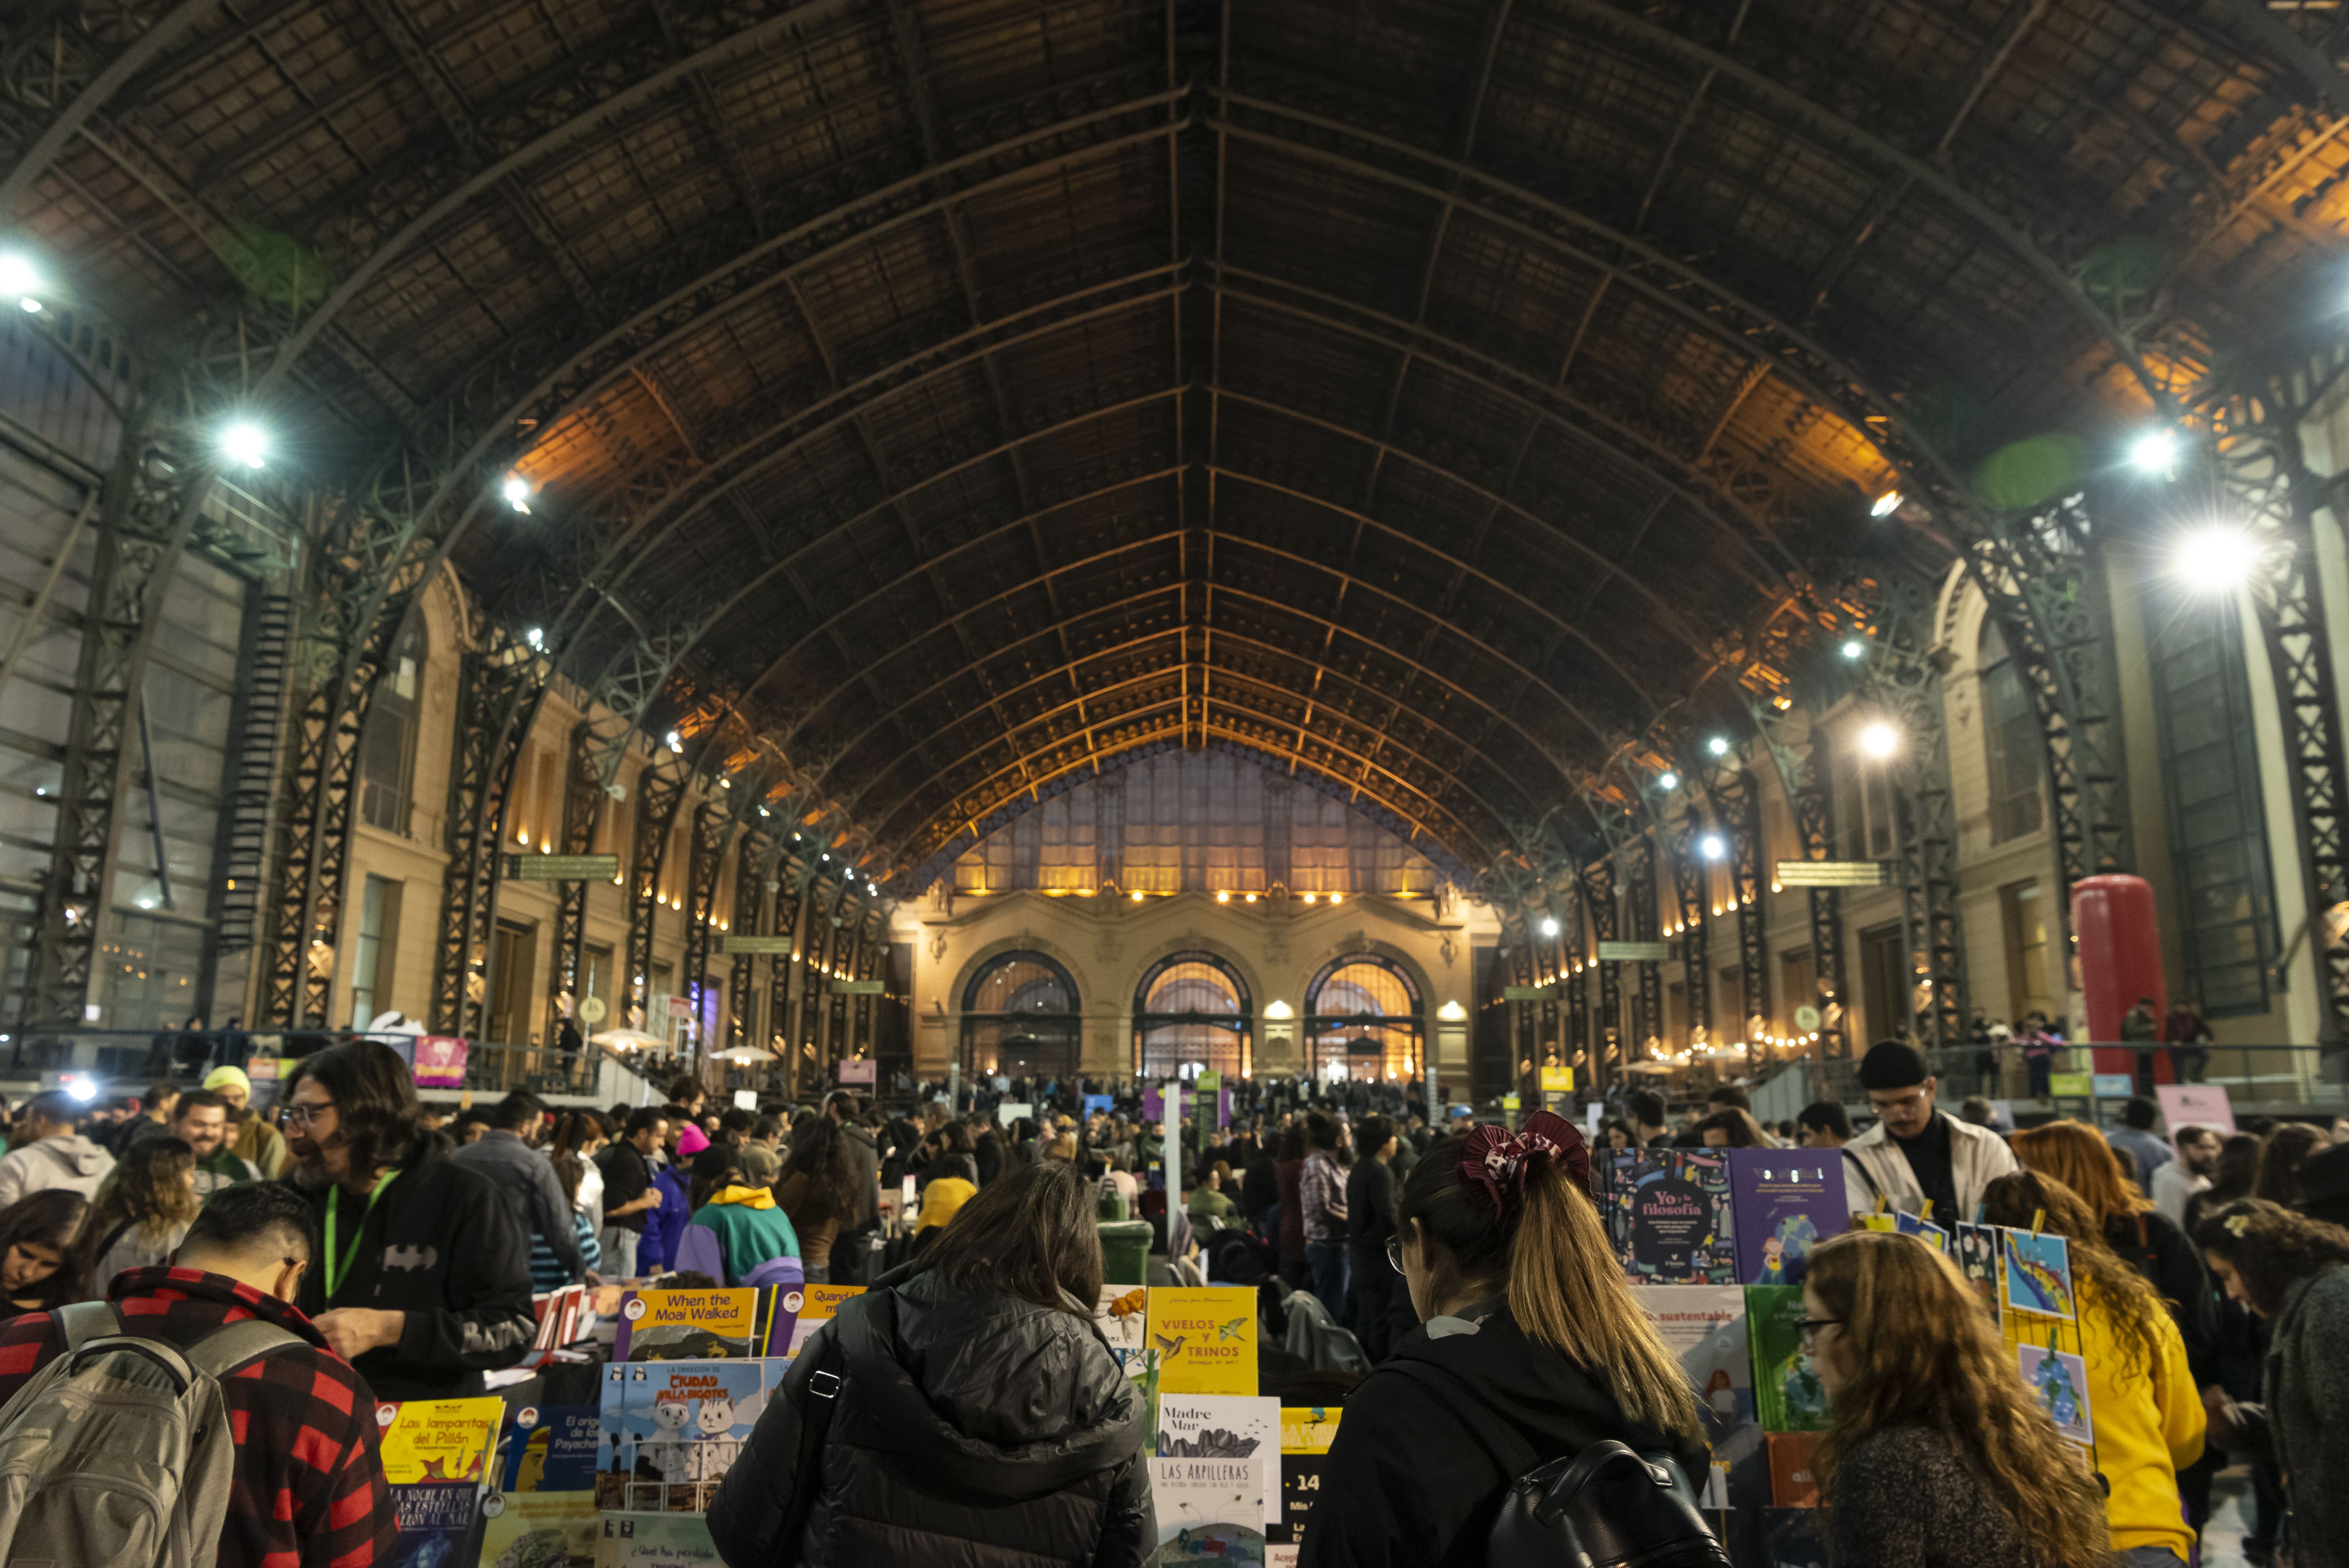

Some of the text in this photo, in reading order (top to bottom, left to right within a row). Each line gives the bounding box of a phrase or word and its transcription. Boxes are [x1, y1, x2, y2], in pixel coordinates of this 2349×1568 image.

[1654, 1190, 1676, 1205] Yo
[1643, 1203, 1701, 1215] filosofía
[667, 1294, 731, 1307] When the
[655, 1306, 739, 1320] Moai Walked
[1659, 1310, 1732, 1321] sustentable
[1162, 1320, 1215, 1329] VUELOS
[1202, 1333, 1210, 1343] Y
[1187, 1346, 1238, 1357] TRINOS
[670, 1374, 718, 1388] CIUDAD
[1165, 1407, 1211, 1419] Madre
[400, 1417, 489, 1431] Las lamparitas
[566, 1416, 576, 1426] El
[1172, 1420, 1199, 1430] Mar
[413, 1432, 468, 1444] del Pillán
[570, 1428, 583, 1438] de
[555, 1438, 598, 1451] Payacha
[1161, 1463, 1248, 1480] LAS ARPILLERAS
[1297, 1475, 1319, 1490] 14
[406, 1488, 436, 1502] NOCHE
[661, 1545, 673, 1556] ha
